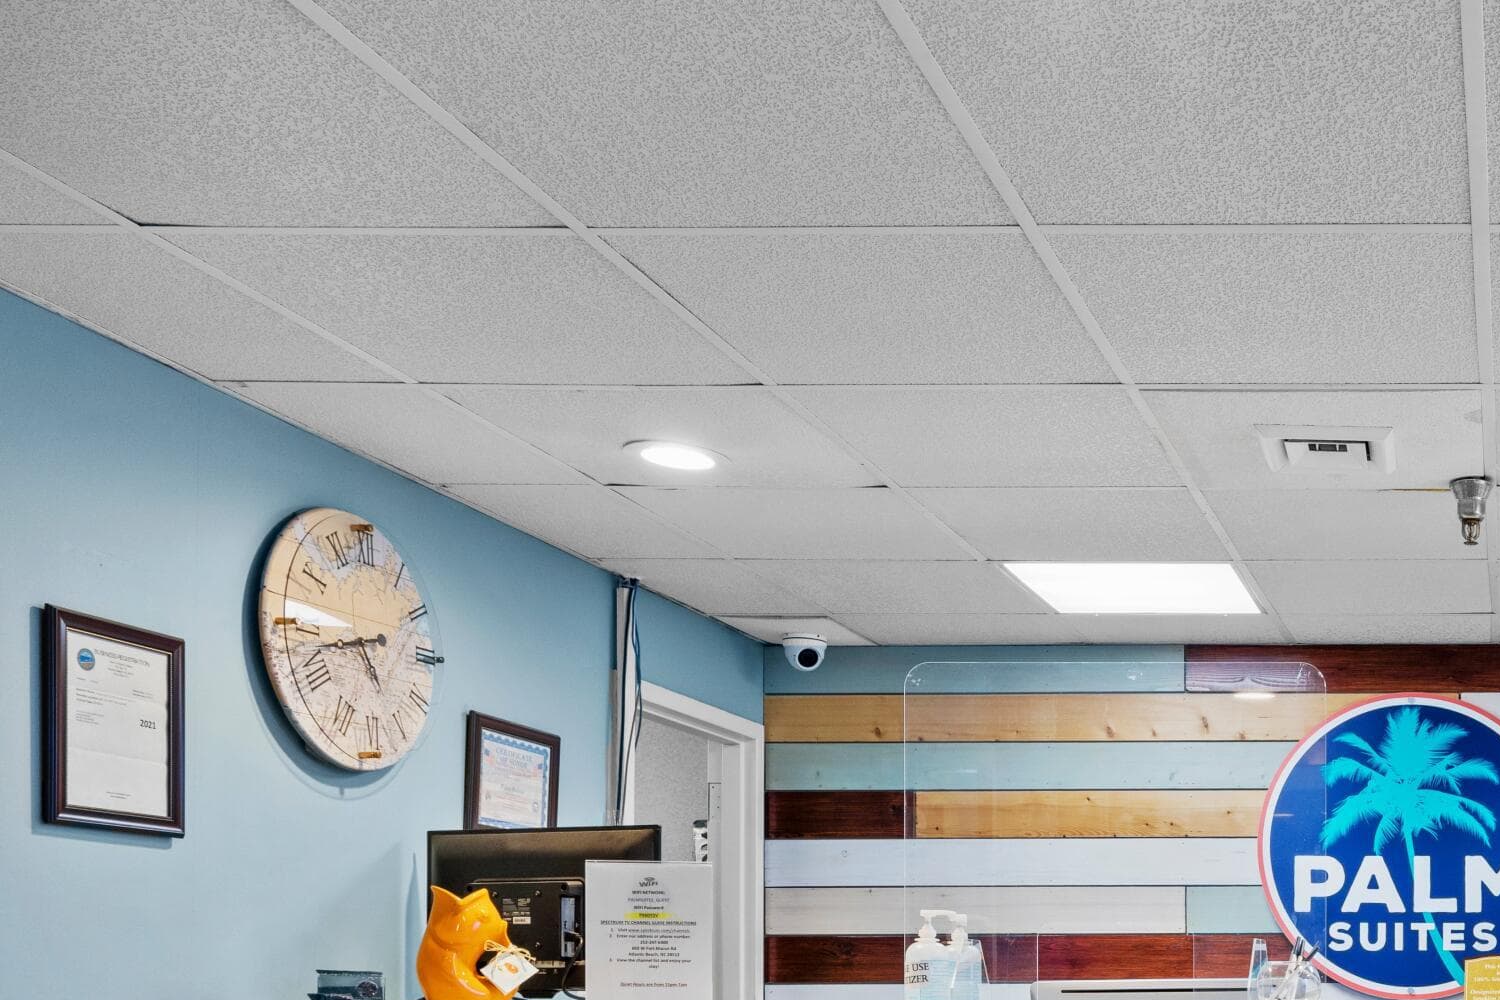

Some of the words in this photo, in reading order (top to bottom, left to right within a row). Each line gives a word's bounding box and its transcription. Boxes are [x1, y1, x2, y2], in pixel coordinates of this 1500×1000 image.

[140, 719, 157, 730] 2021
[1328, 921, 1497, 952] SUITES
[912, 962, 929, 972] USE
